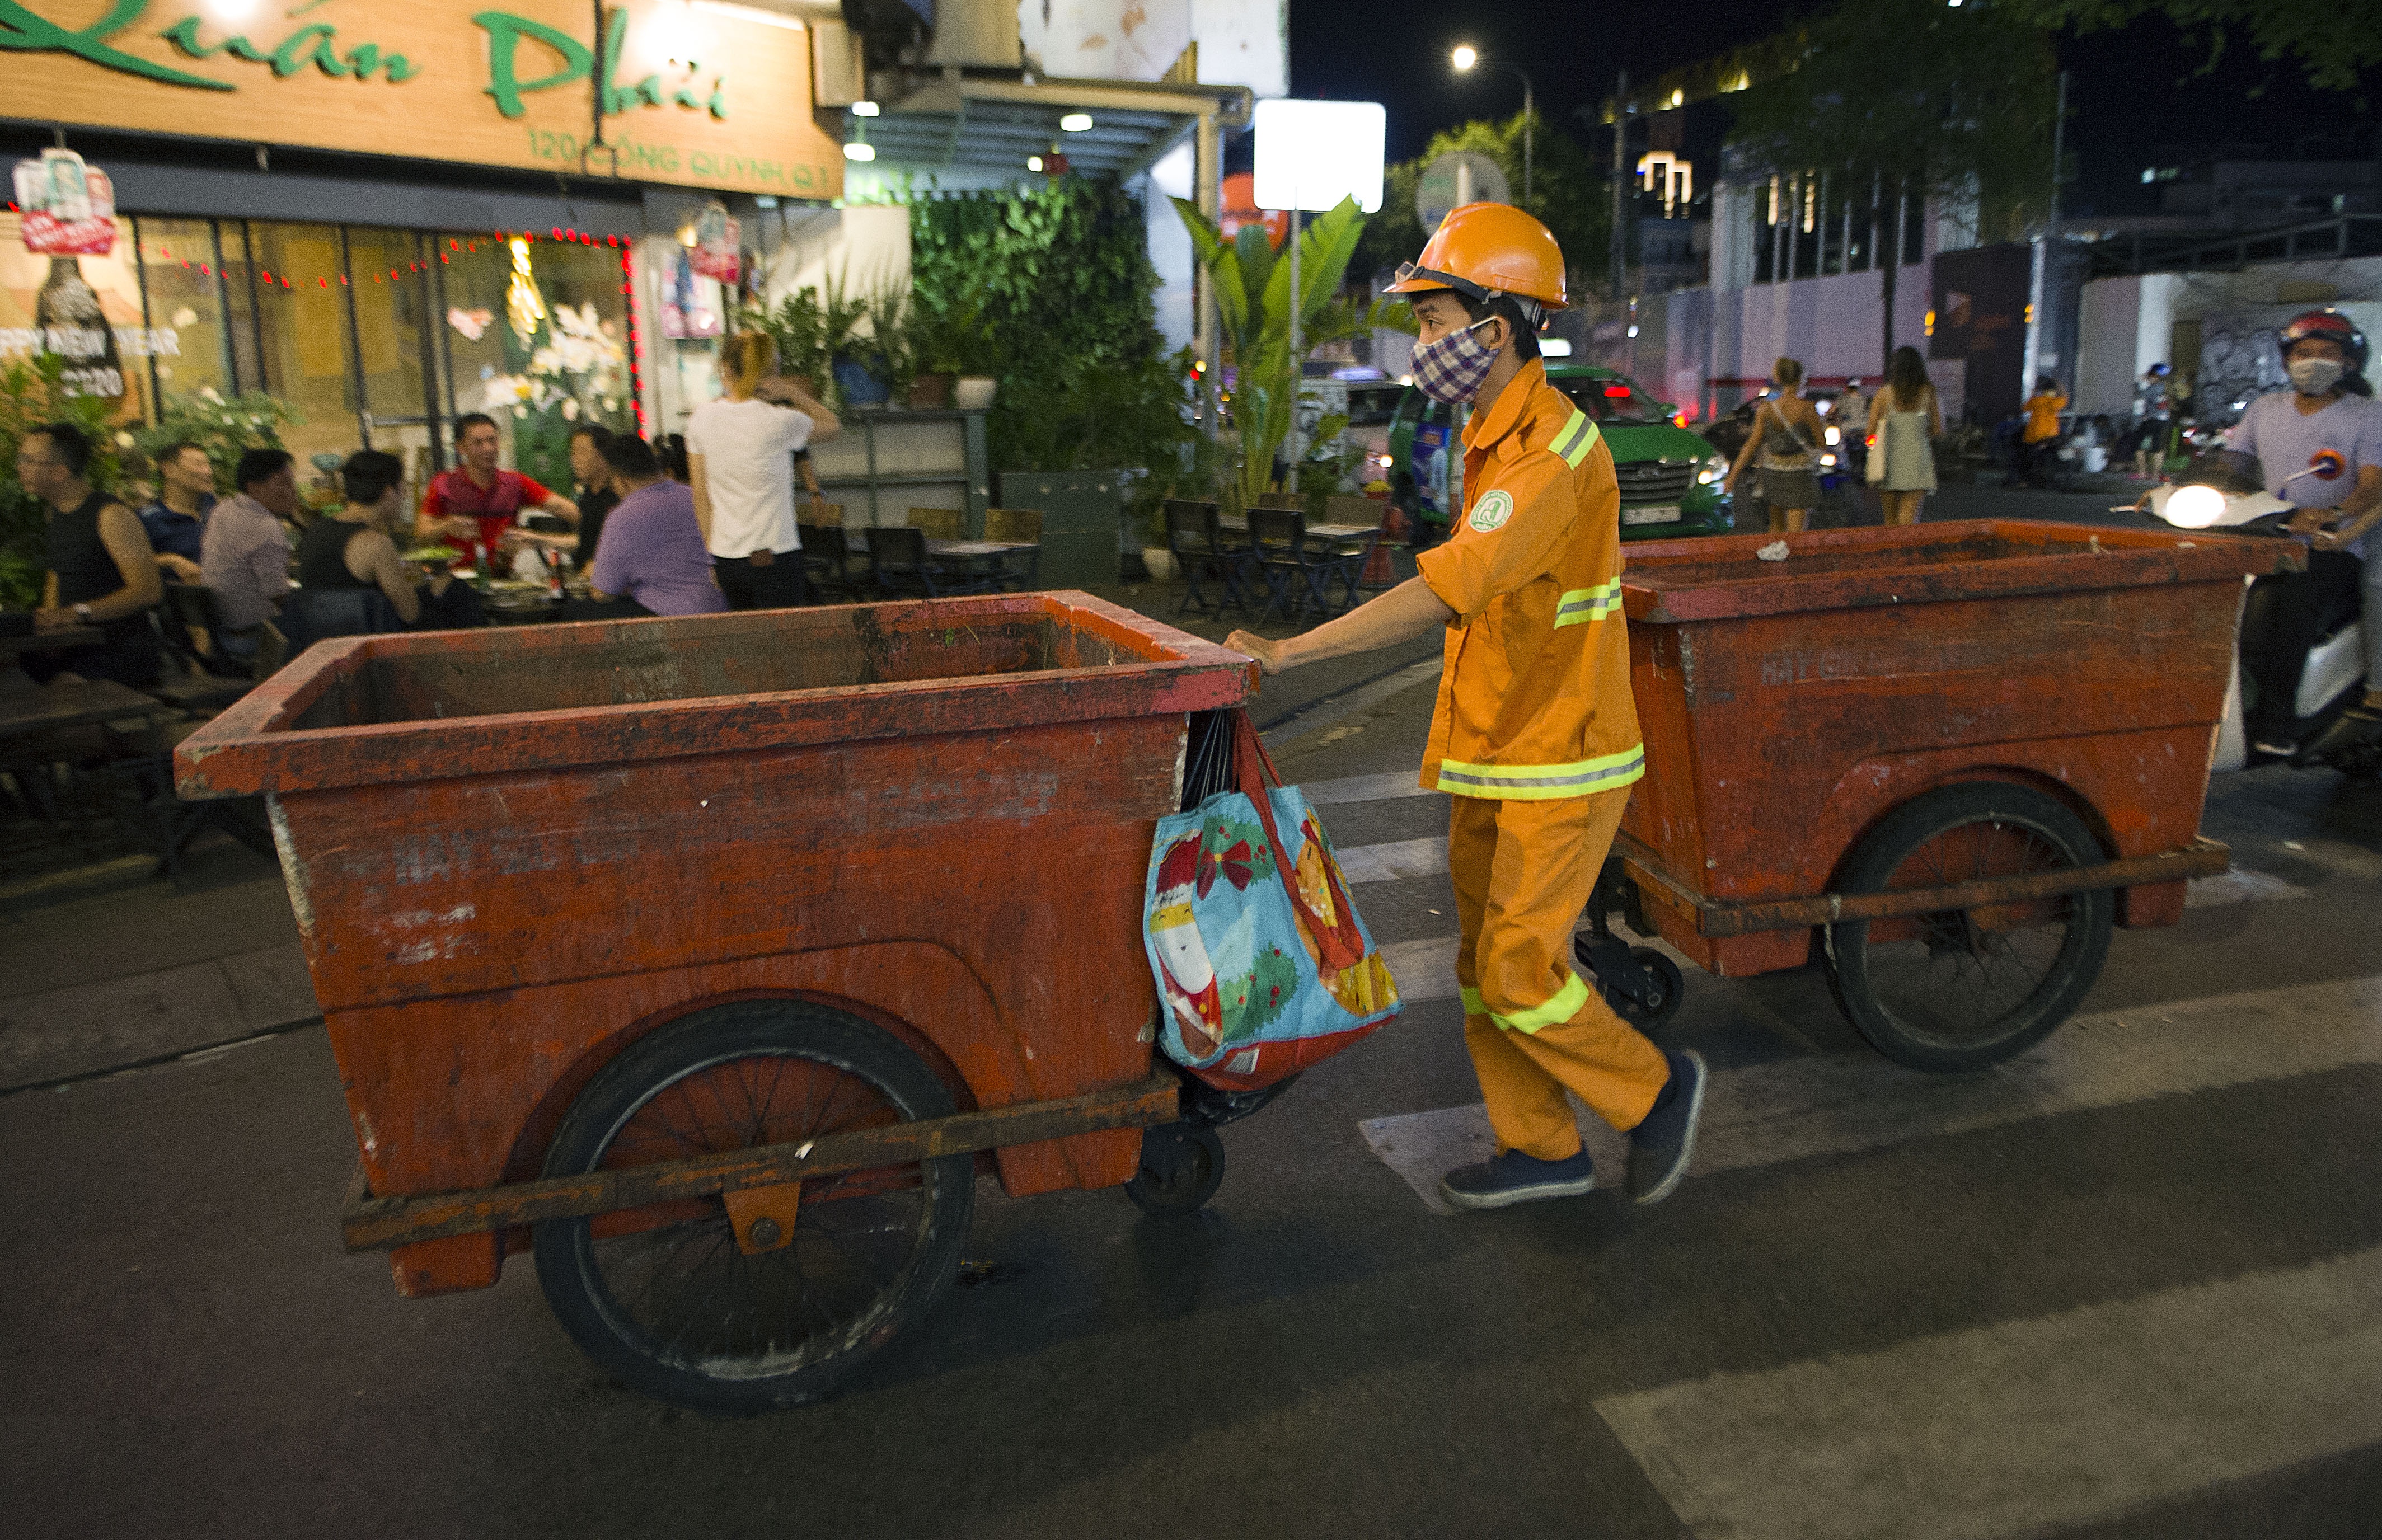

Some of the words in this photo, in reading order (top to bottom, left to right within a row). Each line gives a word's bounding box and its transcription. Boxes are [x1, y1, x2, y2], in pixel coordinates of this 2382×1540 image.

[528, 129, 577, 161] 120
[47, 328, 106, 358] NEW
[114, 327, 180, 355] YEAR
